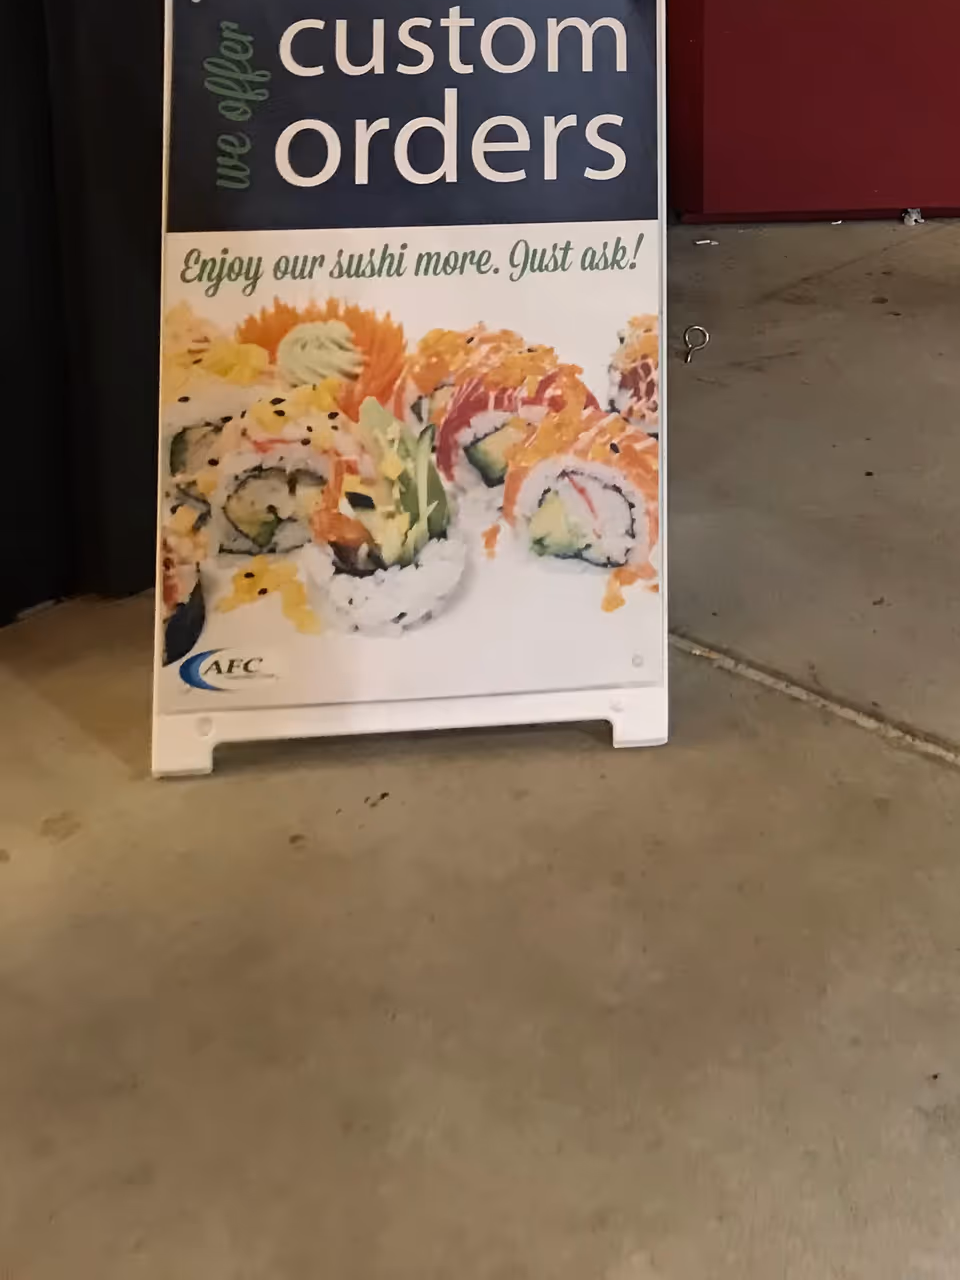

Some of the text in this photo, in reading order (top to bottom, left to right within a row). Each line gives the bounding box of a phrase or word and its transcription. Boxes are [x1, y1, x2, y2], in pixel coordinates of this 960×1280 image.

[279, 5, 628, 77] custom
[204, 21, 271, 189] we offer
[275, 87, 627, 188] orders
[180, 232, 645, 297] Enjoy our sushi more. Just ask!
[203, 657, 263, 675] AFC
